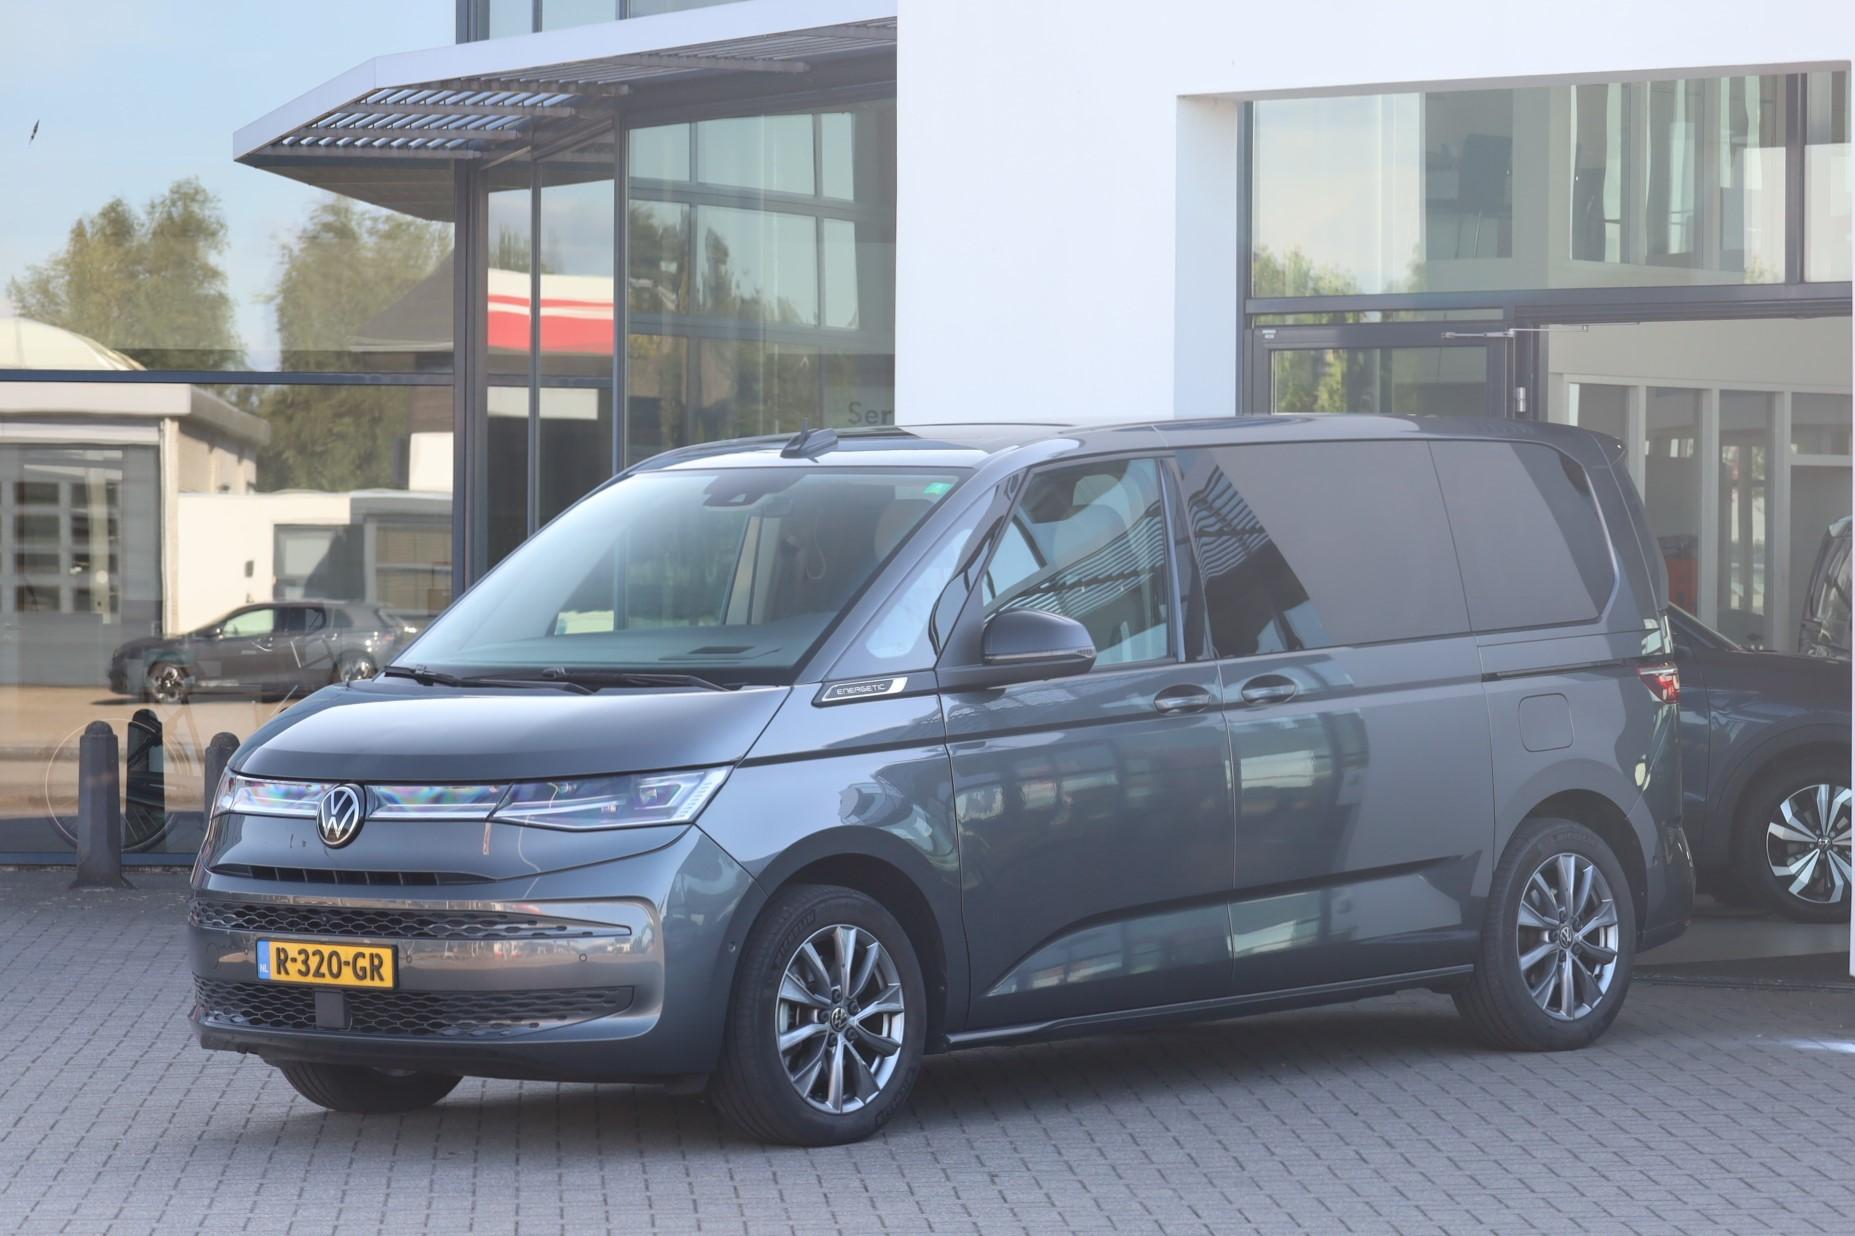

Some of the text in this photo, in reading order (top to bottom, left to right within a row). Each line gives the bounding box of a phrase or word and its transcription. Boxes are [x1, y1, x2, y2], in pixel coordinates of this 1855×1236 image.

[848, 401, 892, 425] Ser
[836, 683, 886, 696] ENERGETIC
[259, 963, 269, 974] NL
[275, 946, 385, 982] R-320-GR
